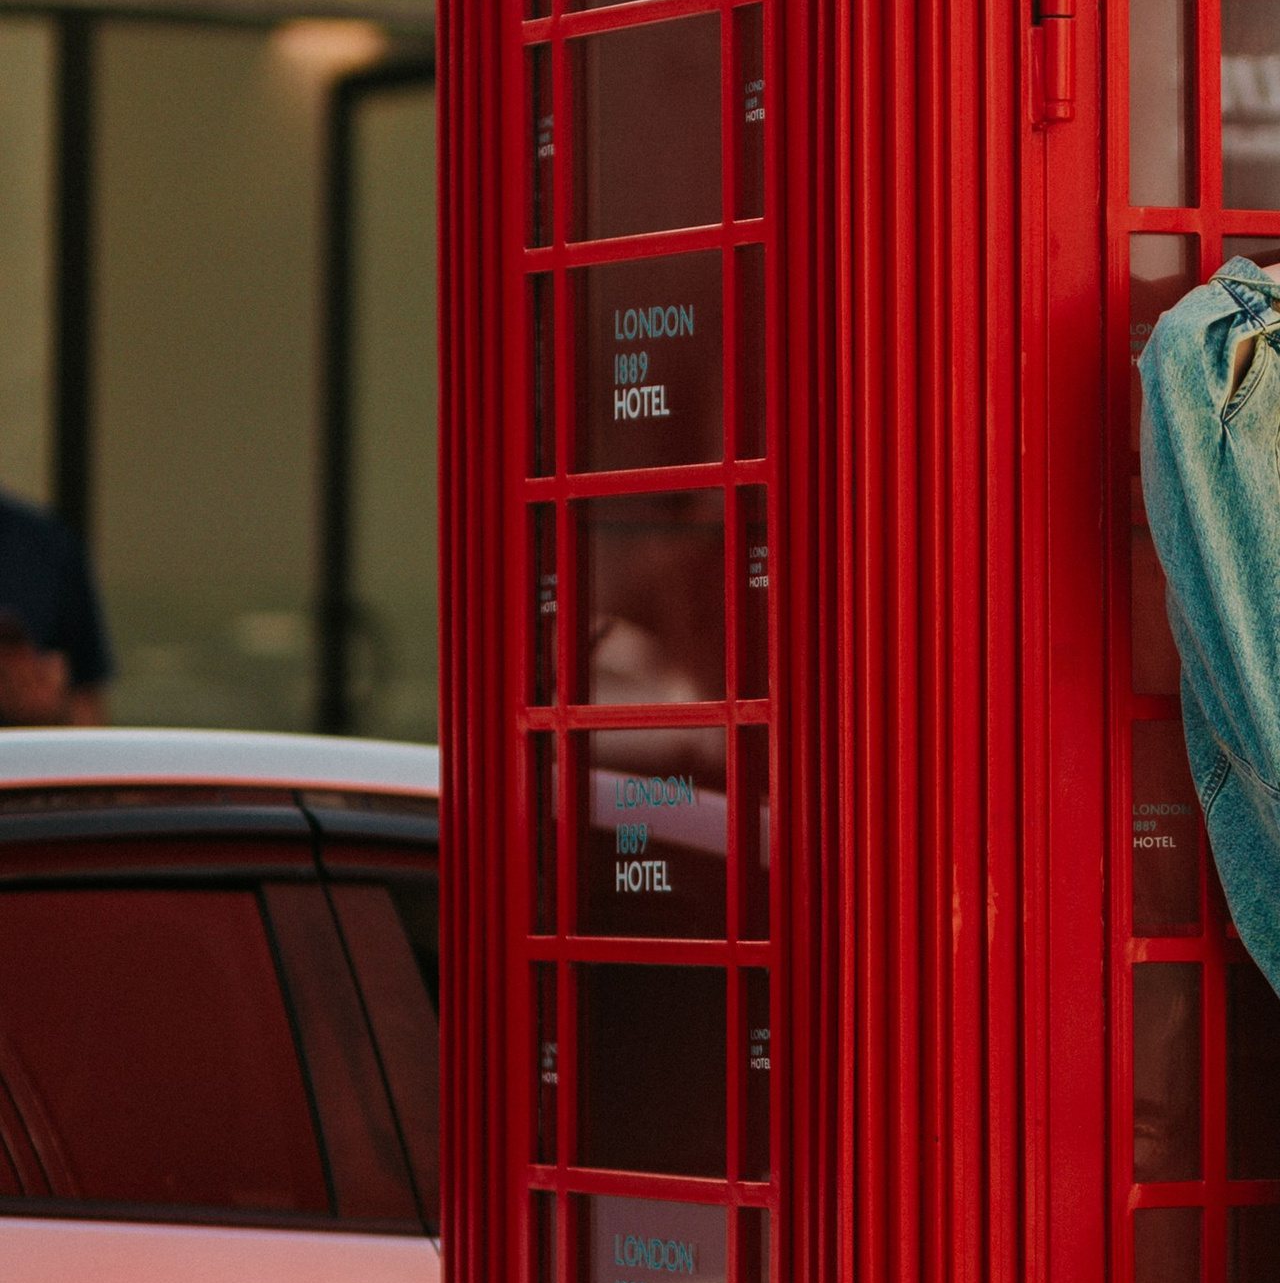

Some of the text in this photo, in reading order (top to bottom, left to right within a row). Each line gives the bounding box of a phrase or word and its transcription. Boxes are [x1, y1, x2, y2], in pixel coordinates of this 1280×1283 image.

[614, 304, 694, 340] LONDON
[614, 351, 648, 385] 1889
[614, 385, 670, 420] HOTEL
[616, 775, 693, 809] LONDON
[1132, 803, 1194, 816] LONDON
[1133, 819, 1157, 833] 1889
[616, 822, 648, 855] 1889
[1133, 835, 1176, 849] HOTEL
[615, 860, 672, 893] HOTEL
[614, 1233, 694, 1275] LONDON
